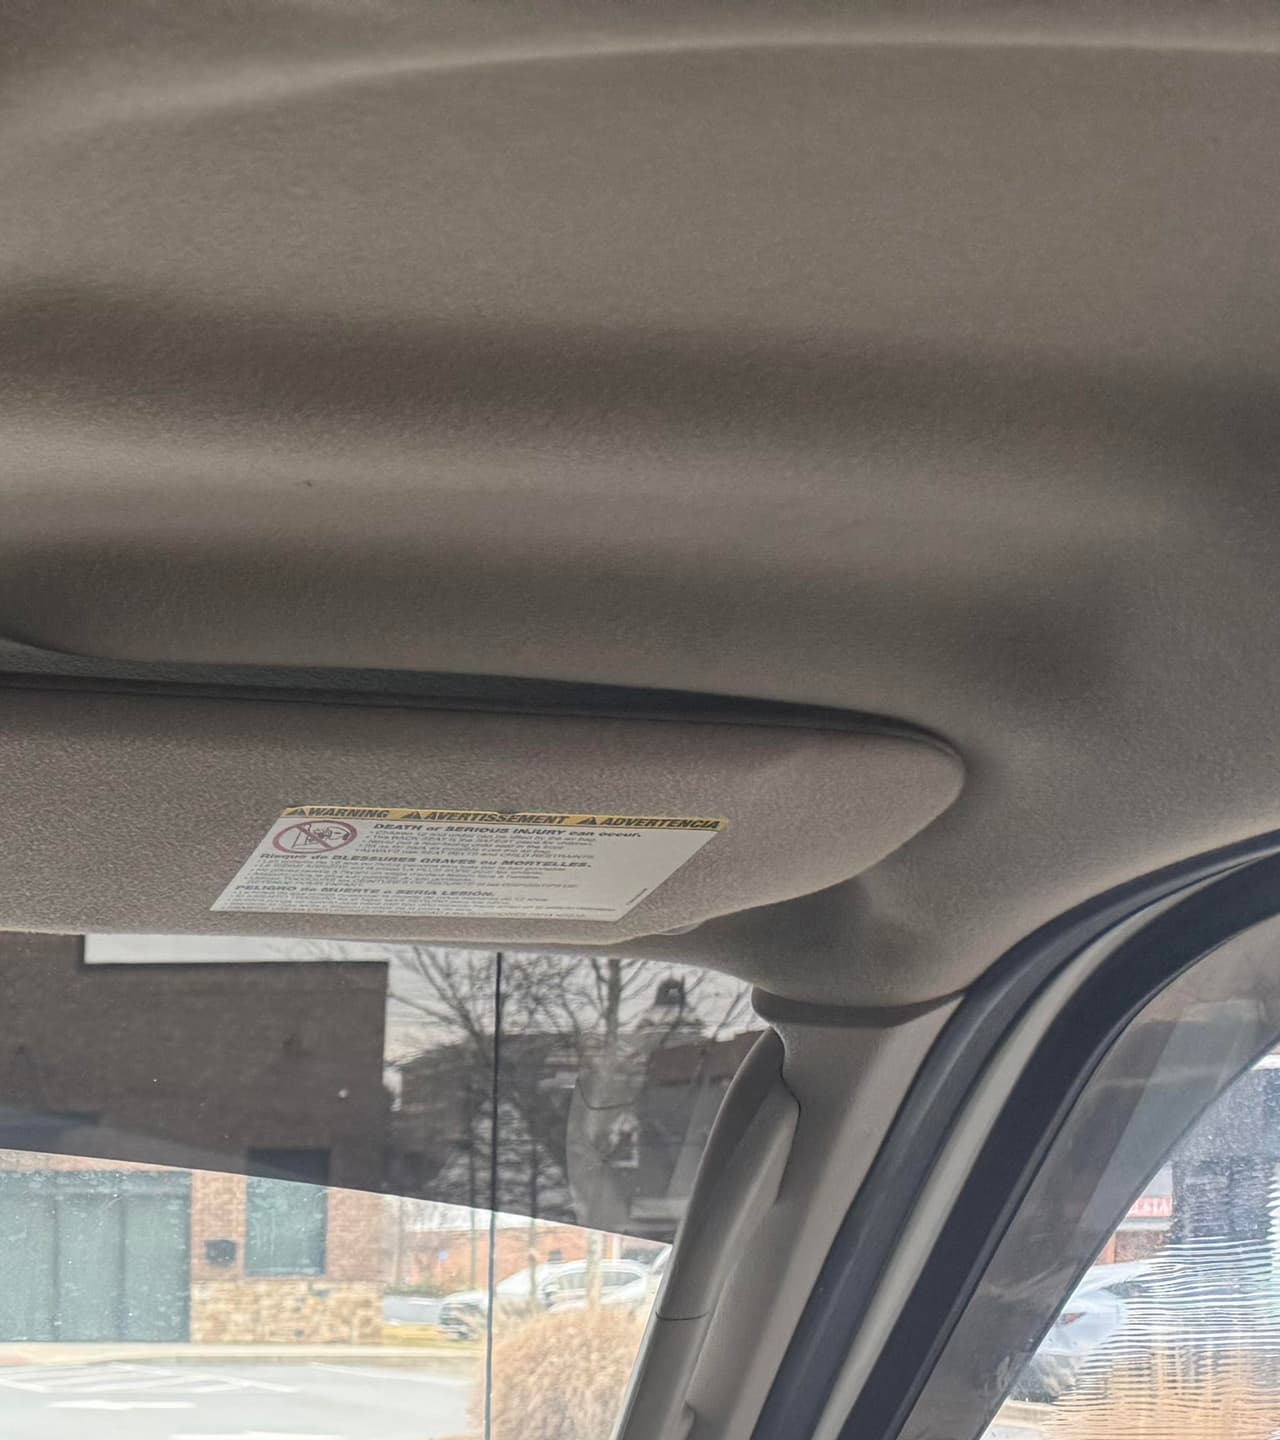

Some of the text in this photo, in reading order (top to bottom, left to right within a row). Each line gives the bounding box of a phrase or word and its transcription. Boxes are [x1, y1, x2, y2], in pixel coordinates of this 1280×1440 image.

[306, 807, 721, 829] WARNING AVERTISSEMENT ADVERTENCIA
[444, 826, 511, 834] SERIOUS
[332, 855, 418, 863] BLESSURES
